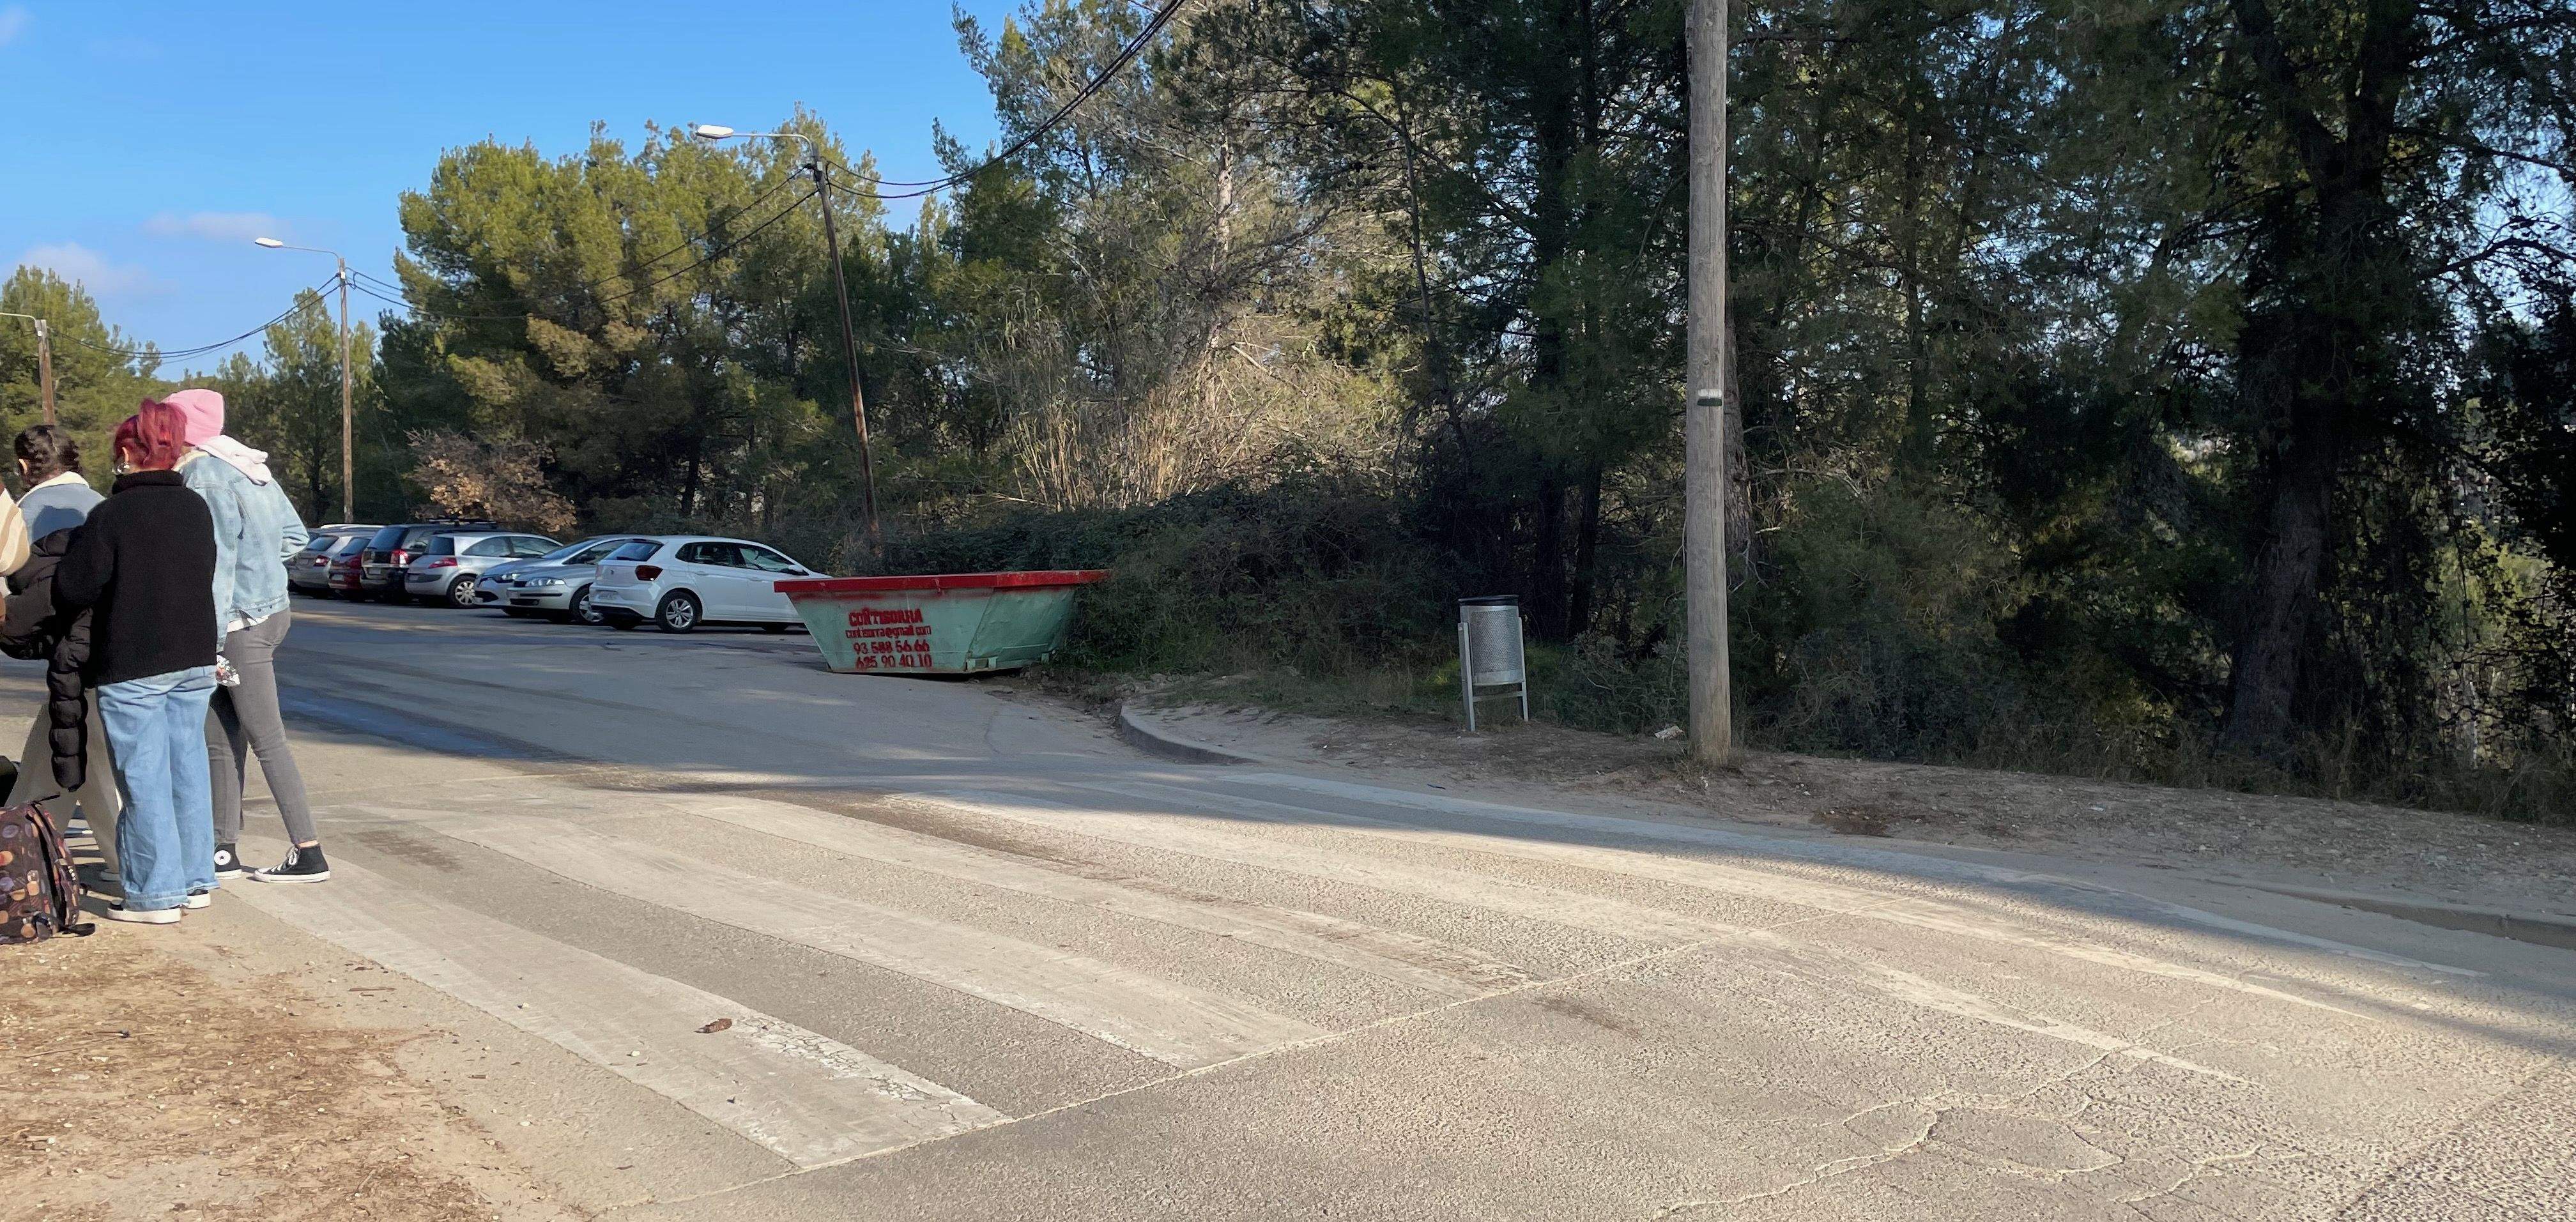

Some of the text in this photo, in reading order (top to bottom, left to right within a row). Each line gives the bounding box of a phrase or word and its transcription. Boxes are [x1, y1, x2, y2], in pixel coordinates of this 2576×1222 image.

[853, 639, 930, 654] 93 588 56 66
[856, 653, 932, 669] 625 90 40 10
